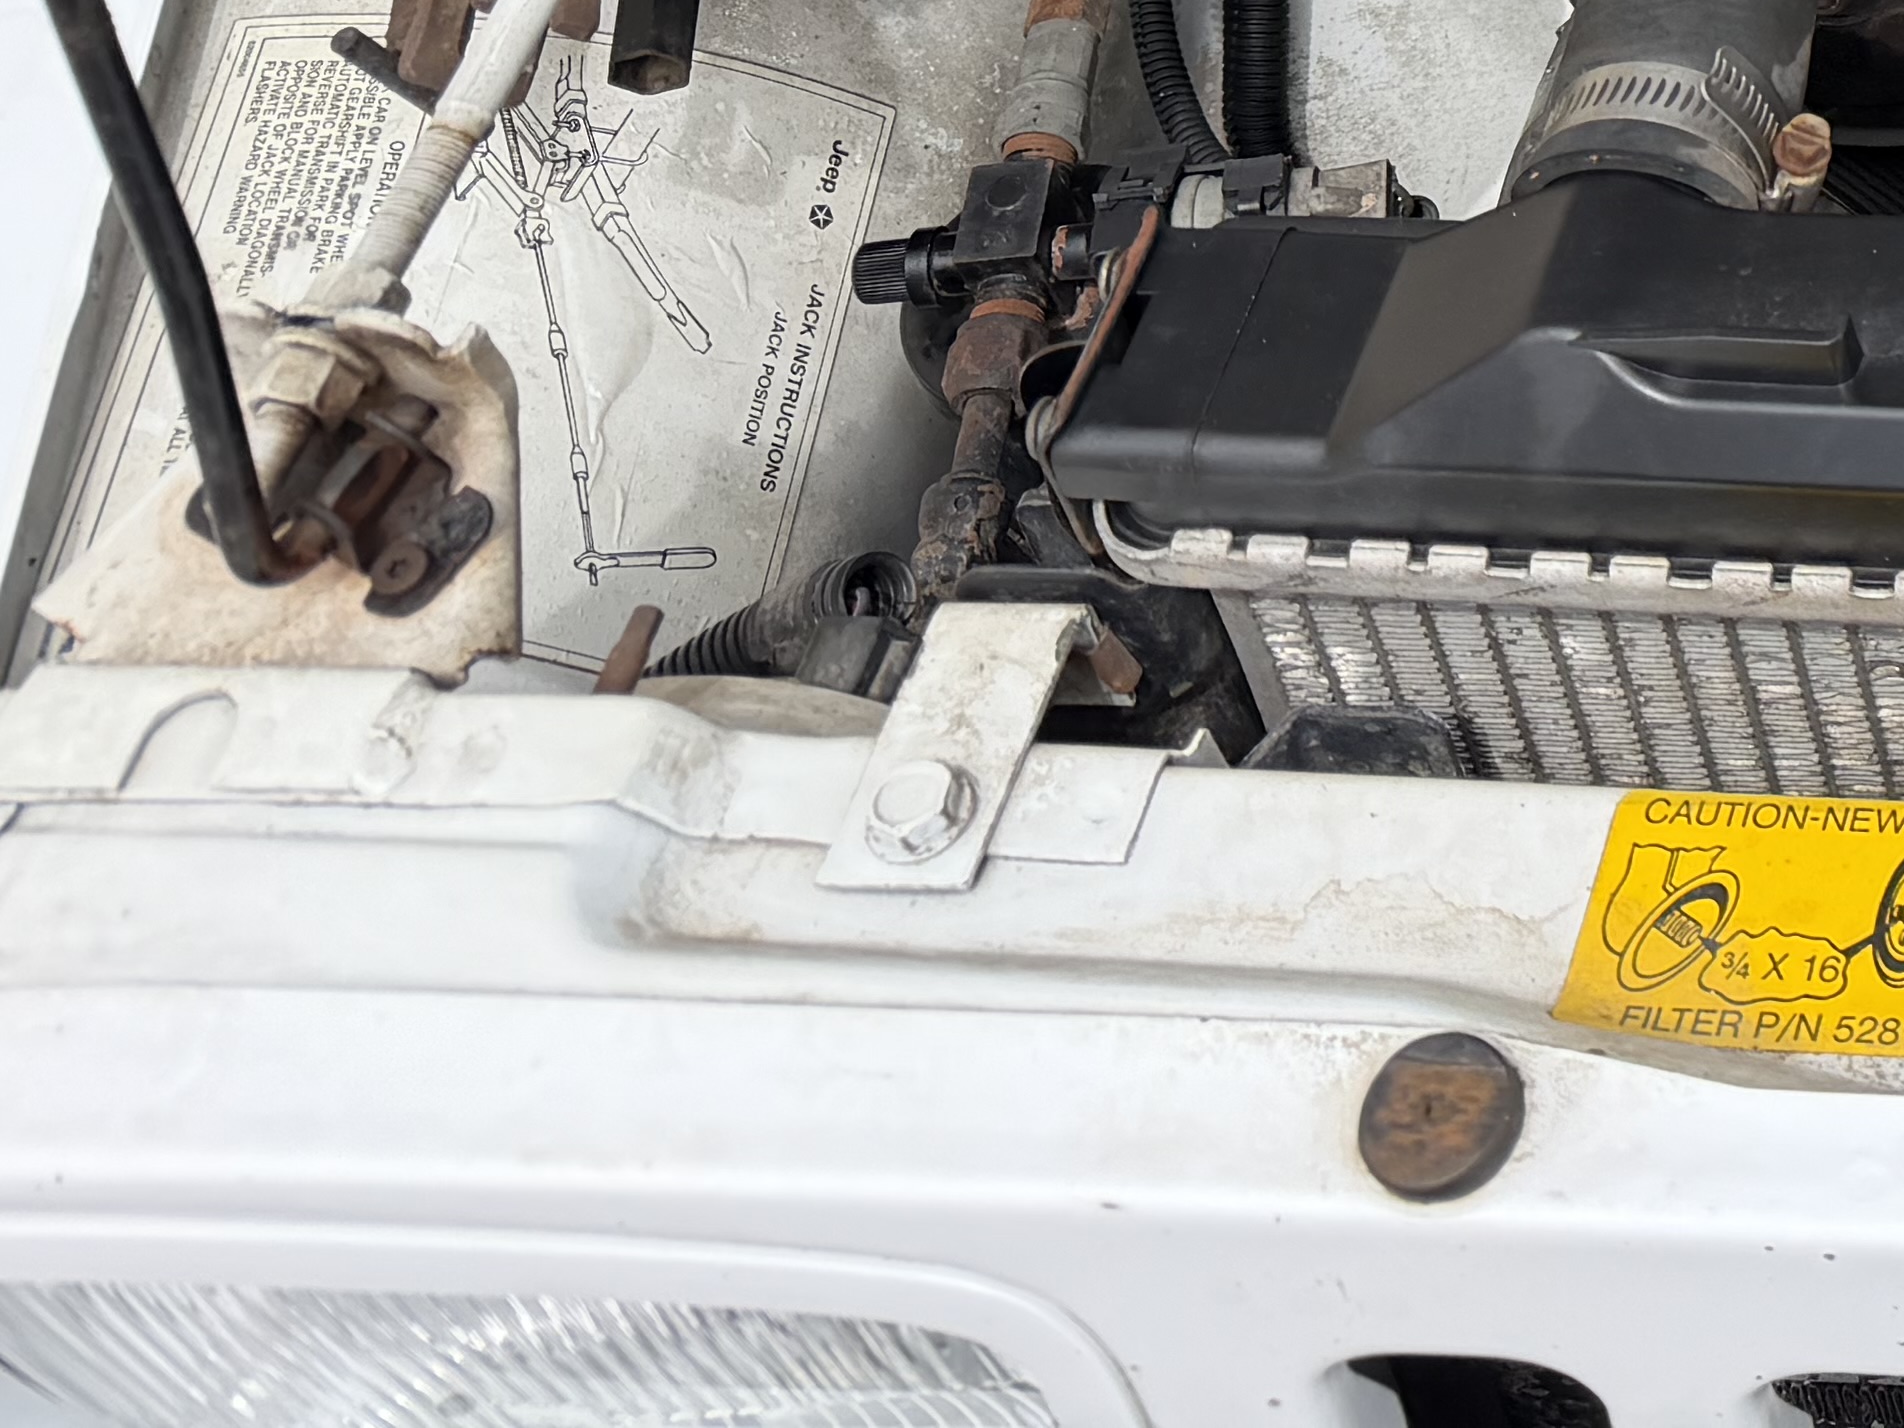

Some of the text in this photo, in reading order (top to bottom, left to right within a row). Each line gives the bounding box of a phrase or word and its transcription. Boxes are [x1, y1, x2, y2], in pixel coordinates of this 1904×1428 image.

[243, 59, 276, 128] FLASHERS.
[303, 58, 323, 88] SION
[322, 60, 352, 130] AUTOMATIC
[294, 91, 312, 118] AND
[329, 86, 361, 156] GEARSHIFT
[371, 96, 390, 124] CAR
[222, 60, 290, 236] ACTIVATE HAZARD WARNING
[235, 58, 307, 247] OPPOSITE OF JACK LOCATION
[277, 120, 303, 165] BLOCK
[343, 123, 365, 162] APPLY
[365, 125, 381, 145] ON
[257, 58, 338, 279] REVERSE FOR MANUAL TRANSMIS-
[291, 131, 331, 228] TRANSMISSION
[324, 160, 338, 174] IN
[351, 148, 375, 188] LEVEL
[820, 140, 849, 193] Jeep
[261, 168, 287, 215] WHEEL
[311, 176, 333, 212] PARK
[323, 167, 352, 227] PARKING
[339, 191, 361, 229] SPOT
[303, 215, 321, 243] FOR
[329, 231, 349, 264] WHE
[309, 228, 333, 276] BRAKE
[742, 311, 788, 447] JACK POSITION
[760, 283, 825, 494] JACK INSTRUCTIONS
[1761, 953, 1789, 981] X
[1804, 955, 1841, 983] 16
[1618, 1005, 1744, 1039] FILTER
[1753, 1011, 1823, 1043] P/N
